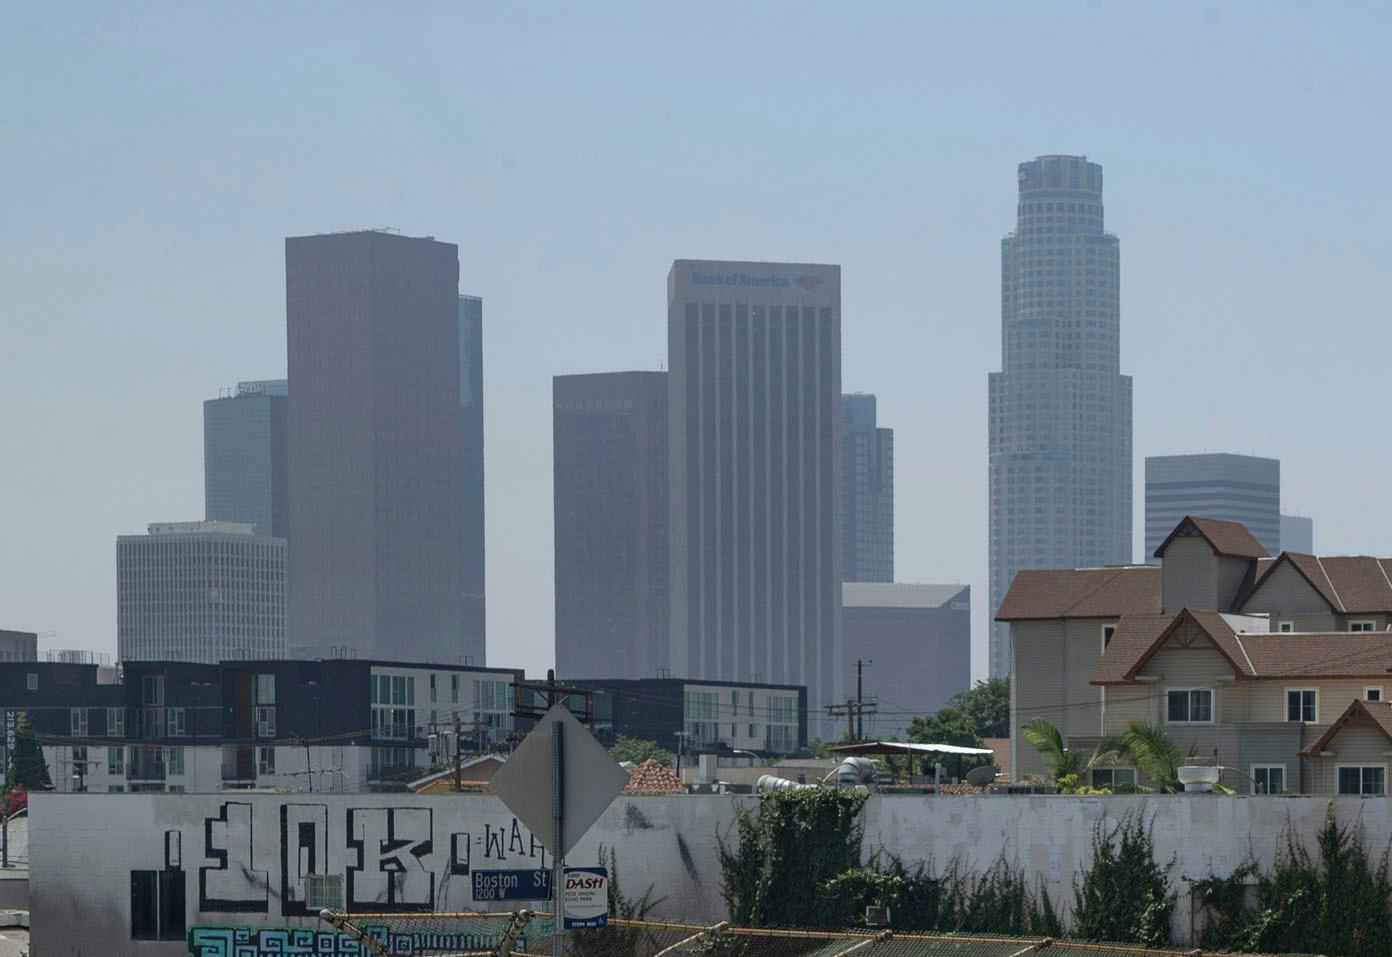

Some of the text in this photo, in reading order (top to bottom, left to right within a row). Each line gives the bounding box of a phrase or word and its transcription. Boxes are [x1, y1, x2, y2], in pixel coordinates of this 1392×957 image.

[475, 871, 547, 889] Boston St
[566, 878, 604, 890] DASH
[475, 887, 506, 900] 1200 W
